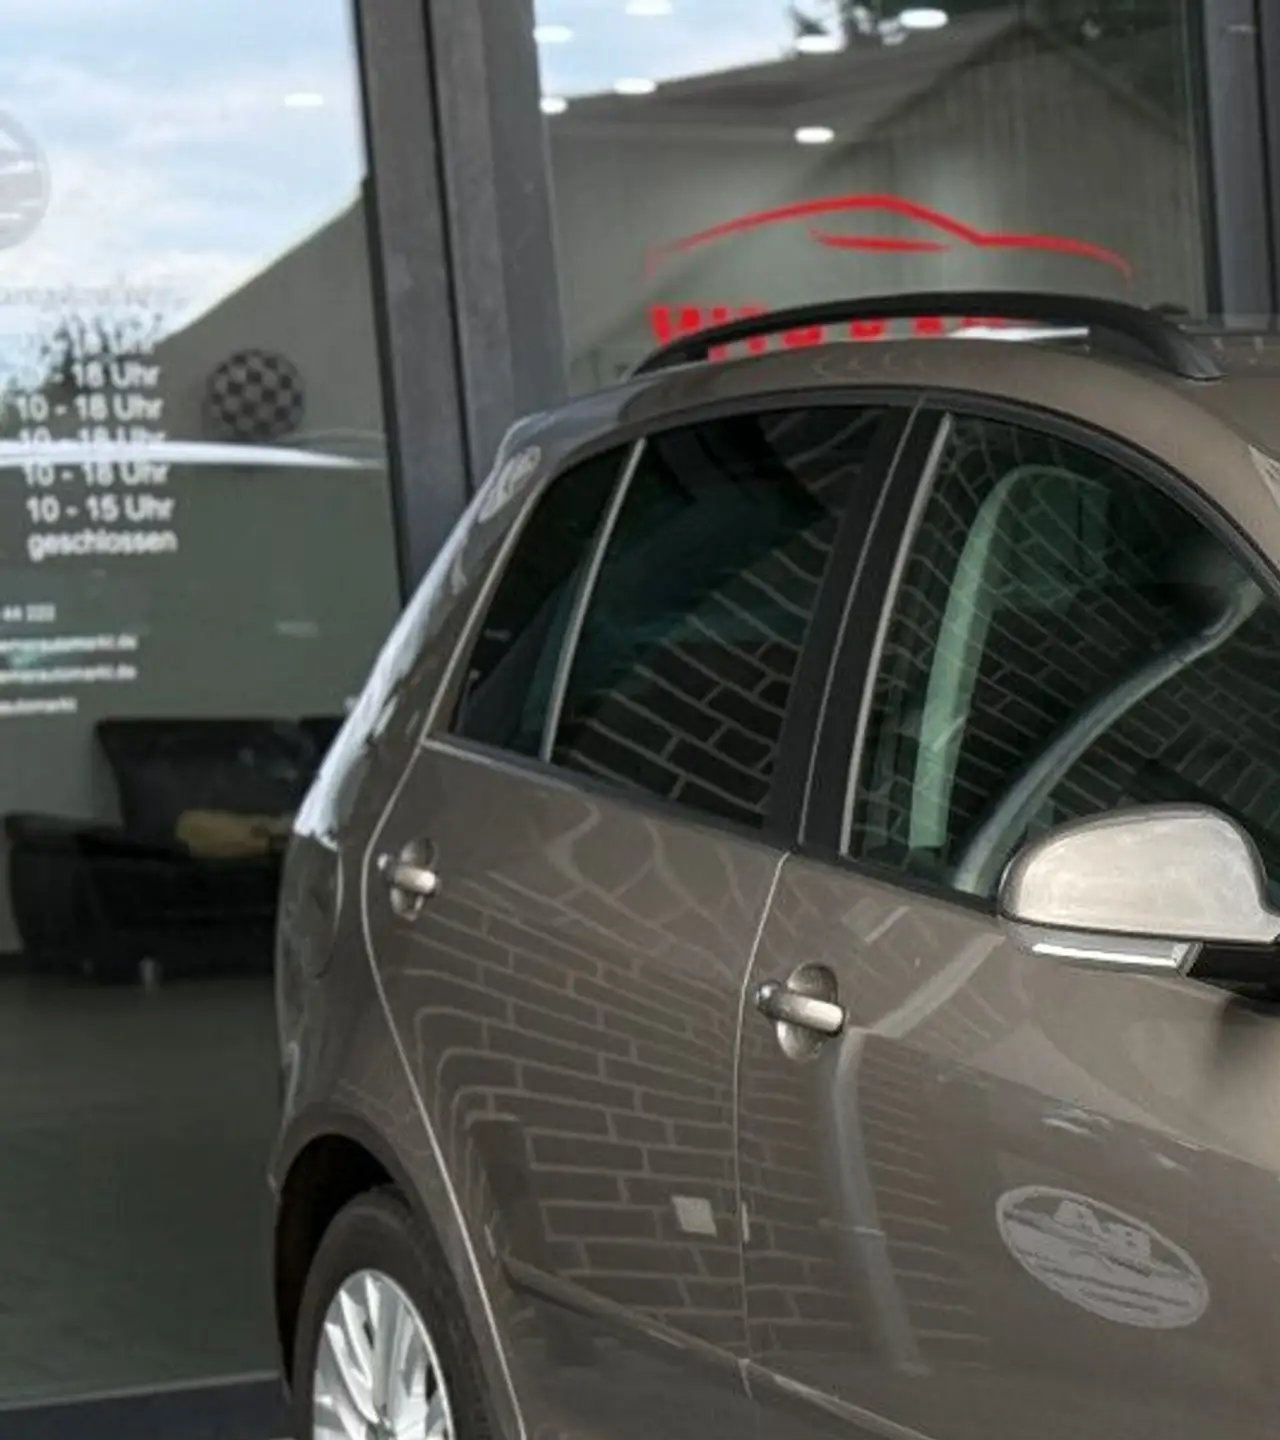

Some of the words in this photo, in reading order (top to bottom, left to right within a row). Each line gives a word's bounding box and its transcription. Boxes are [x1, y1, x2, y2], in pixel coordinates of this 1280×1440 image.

[110, 361, 160, 389] Uhr
[16, 394, 49, 422] 10
[113, 394, 164, 422] Uhr
[120, 460, 171, 486] Uhr
[26, 495, 60, 523] 10
[86, 494, 119, 522] 15
[125, 494, 175, 522] Uhr
[27, 529, 178, 562] geschlossen
